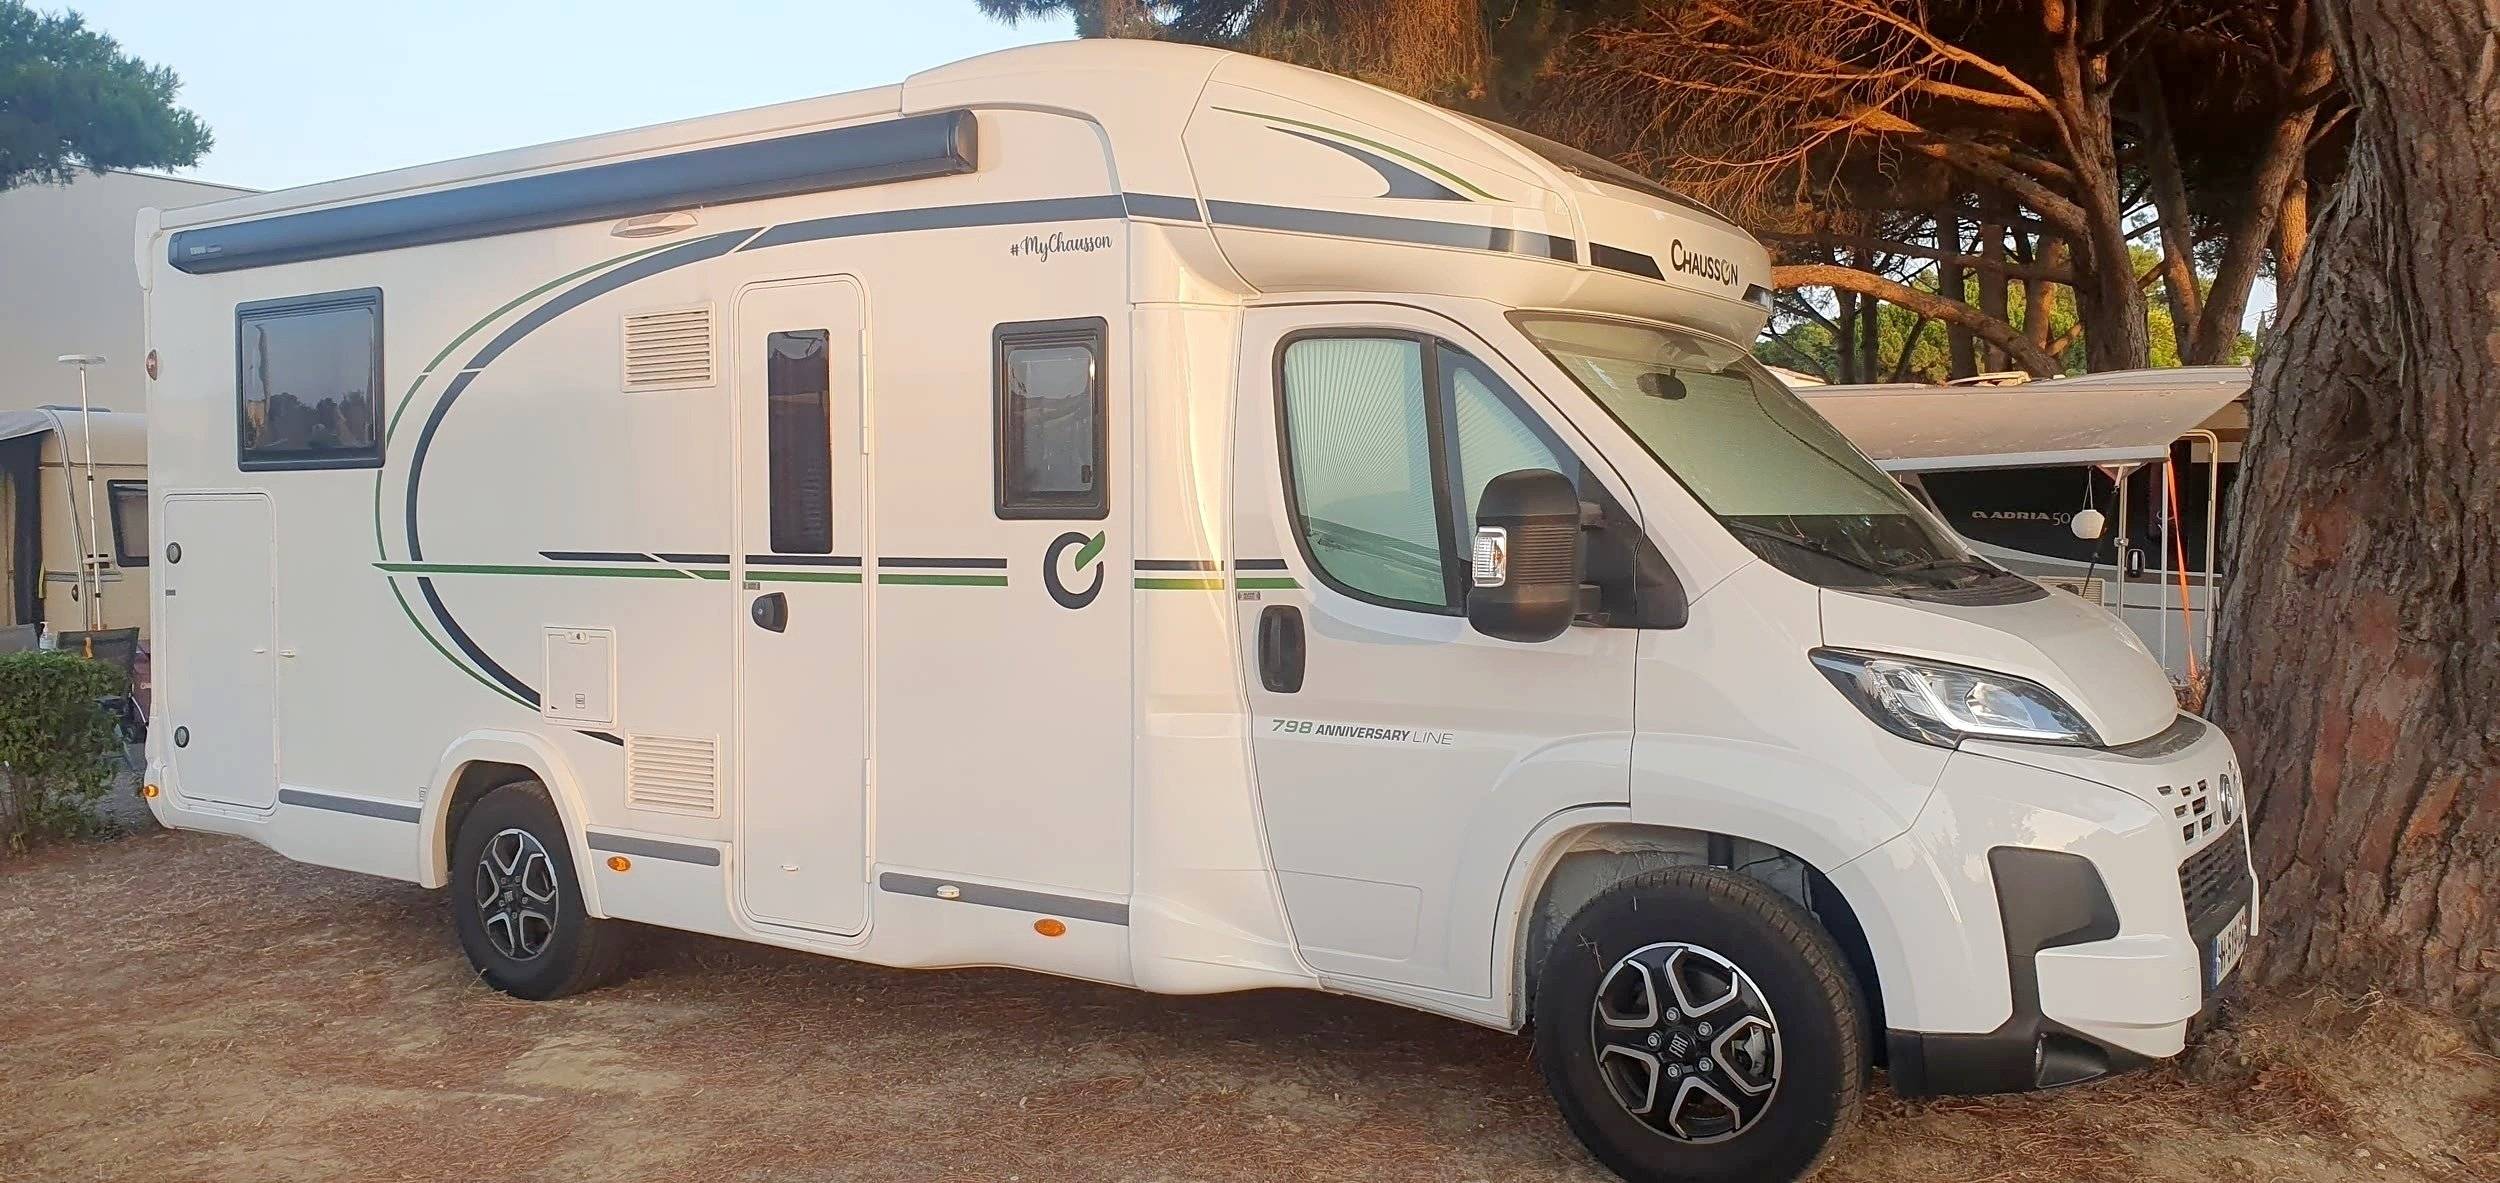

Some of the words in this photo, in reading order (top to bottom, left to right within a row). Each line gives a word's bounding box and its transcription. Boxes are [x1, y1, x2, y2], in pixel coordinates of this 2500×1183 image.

[1010, 232, 1112, 262] #MyChausson
[1671, 239, 1738, 286] CHAUSSON
[1990, 511, 2050, 520] ADRIA
[1272, 719, 1313, 734] 798
[1315, 724, 1410, 742] ANNIVERSARY
[1413, 730, 1454, 745] LINE
[1669, 1033, 1689, 1058] FIAT
